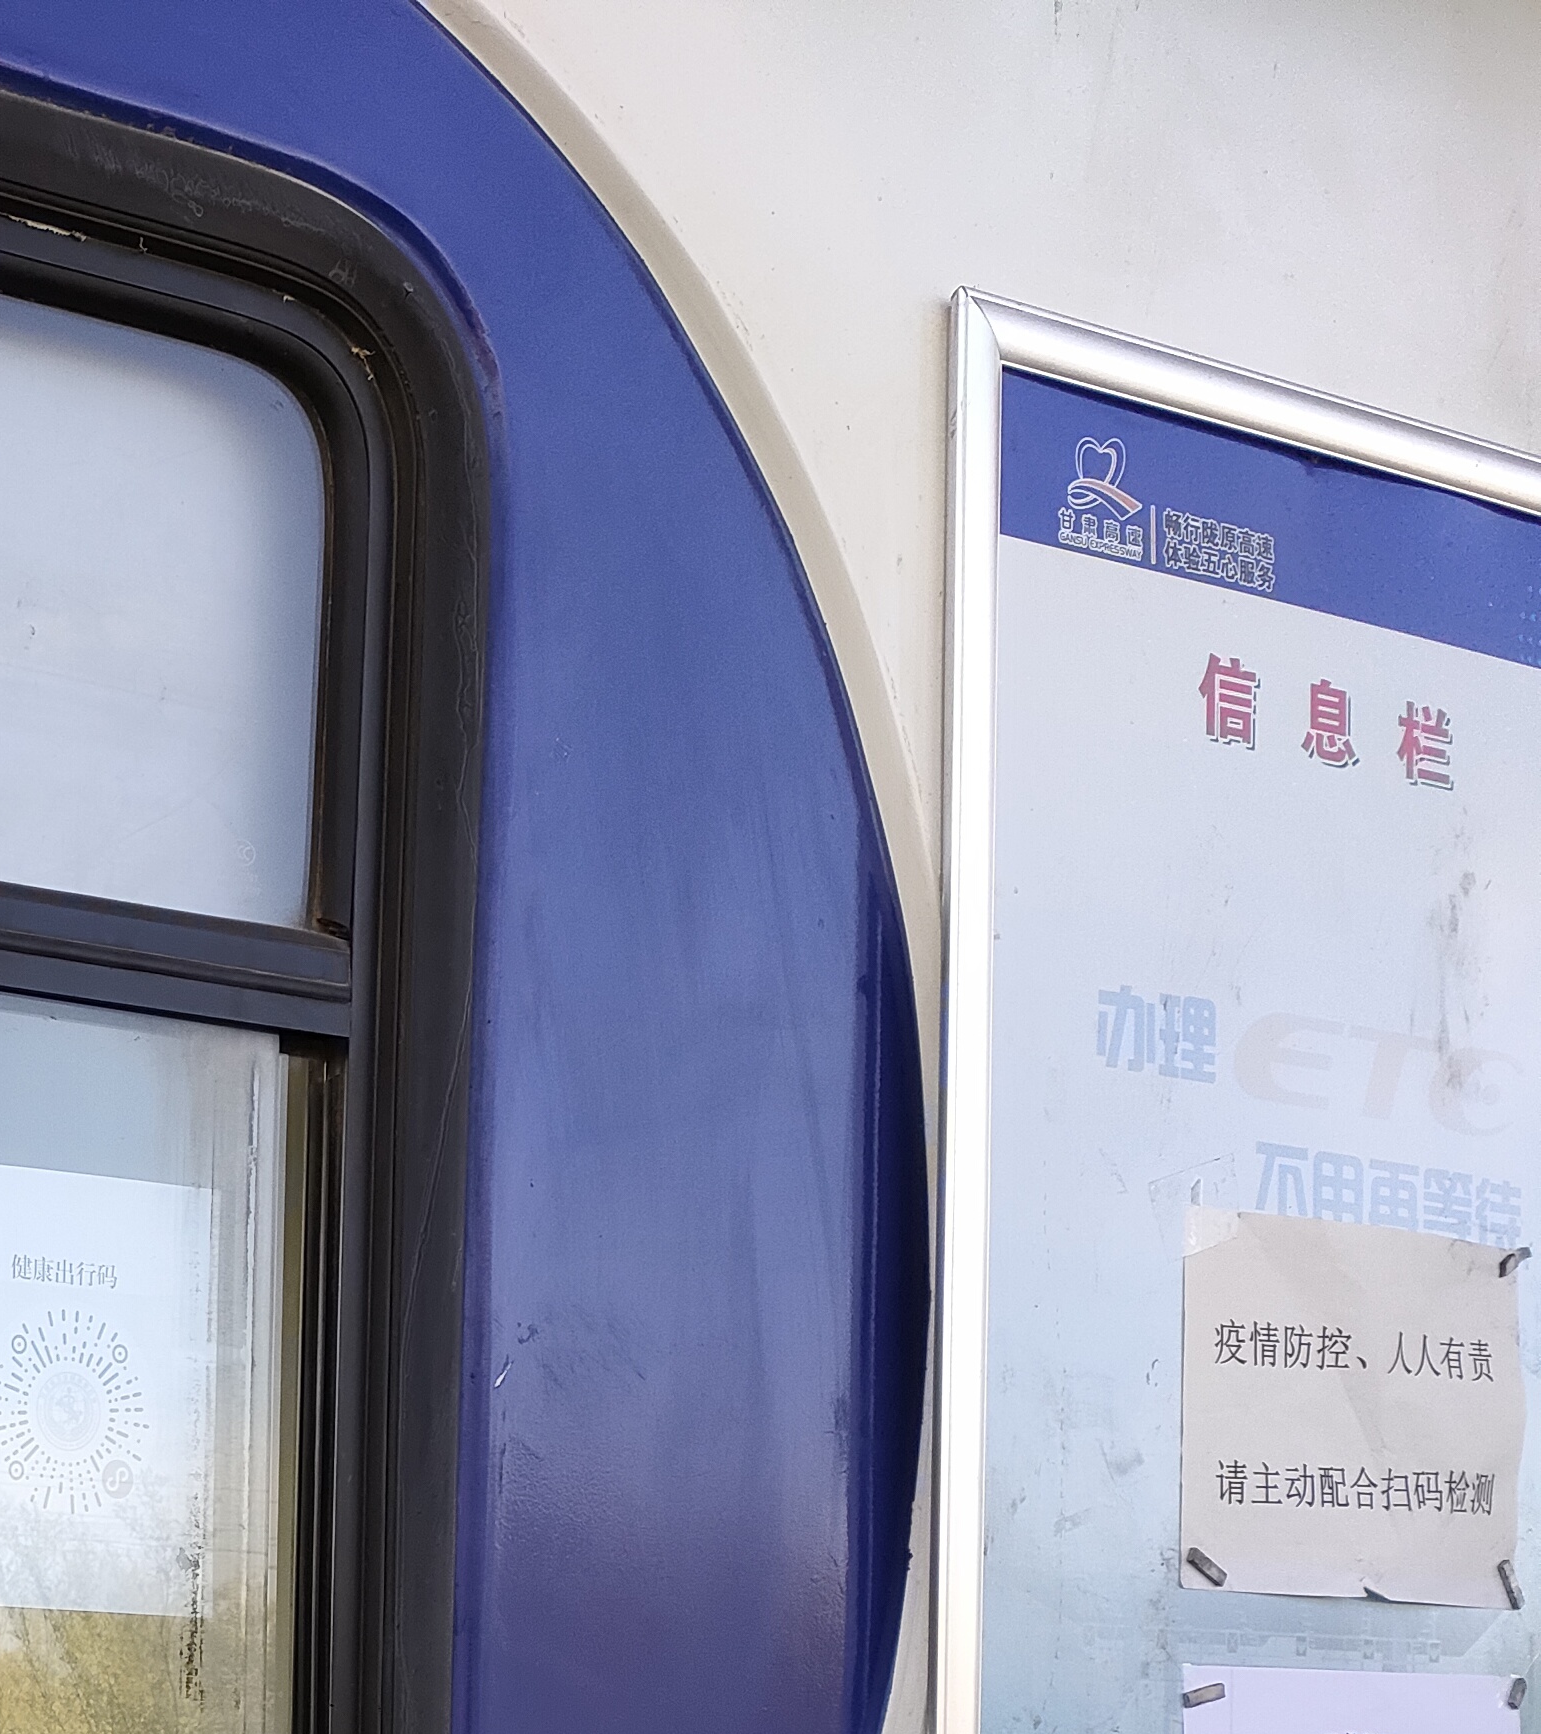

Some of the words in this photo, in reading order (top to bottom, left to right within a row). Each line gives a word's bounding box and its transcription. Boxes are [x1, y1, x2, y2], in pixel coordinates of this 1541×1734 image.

[1057, 530, 1088, 548] GANSU
[1088, 535, 1143, 561] EXPRESSWAY
[1059, 506, 1143, 548] 甘肃高速
[1163, 507, 1275, 563] 畅行陇原高速
[1163, 536, 1276, 593] 体验五心服务
[1198, 651, 1456, 791] 信息栏
[1096, 982, 1217, 1084] 办理
[1232, 1010, 1525, 1138] ETC
[11, 1254, 119, 1290] 健康出行码
[1214, 1317, 1496, 1384] 疫情防控、人人有责
[1215, 1457, 1496, 1517] 请主动配合扫码检测
